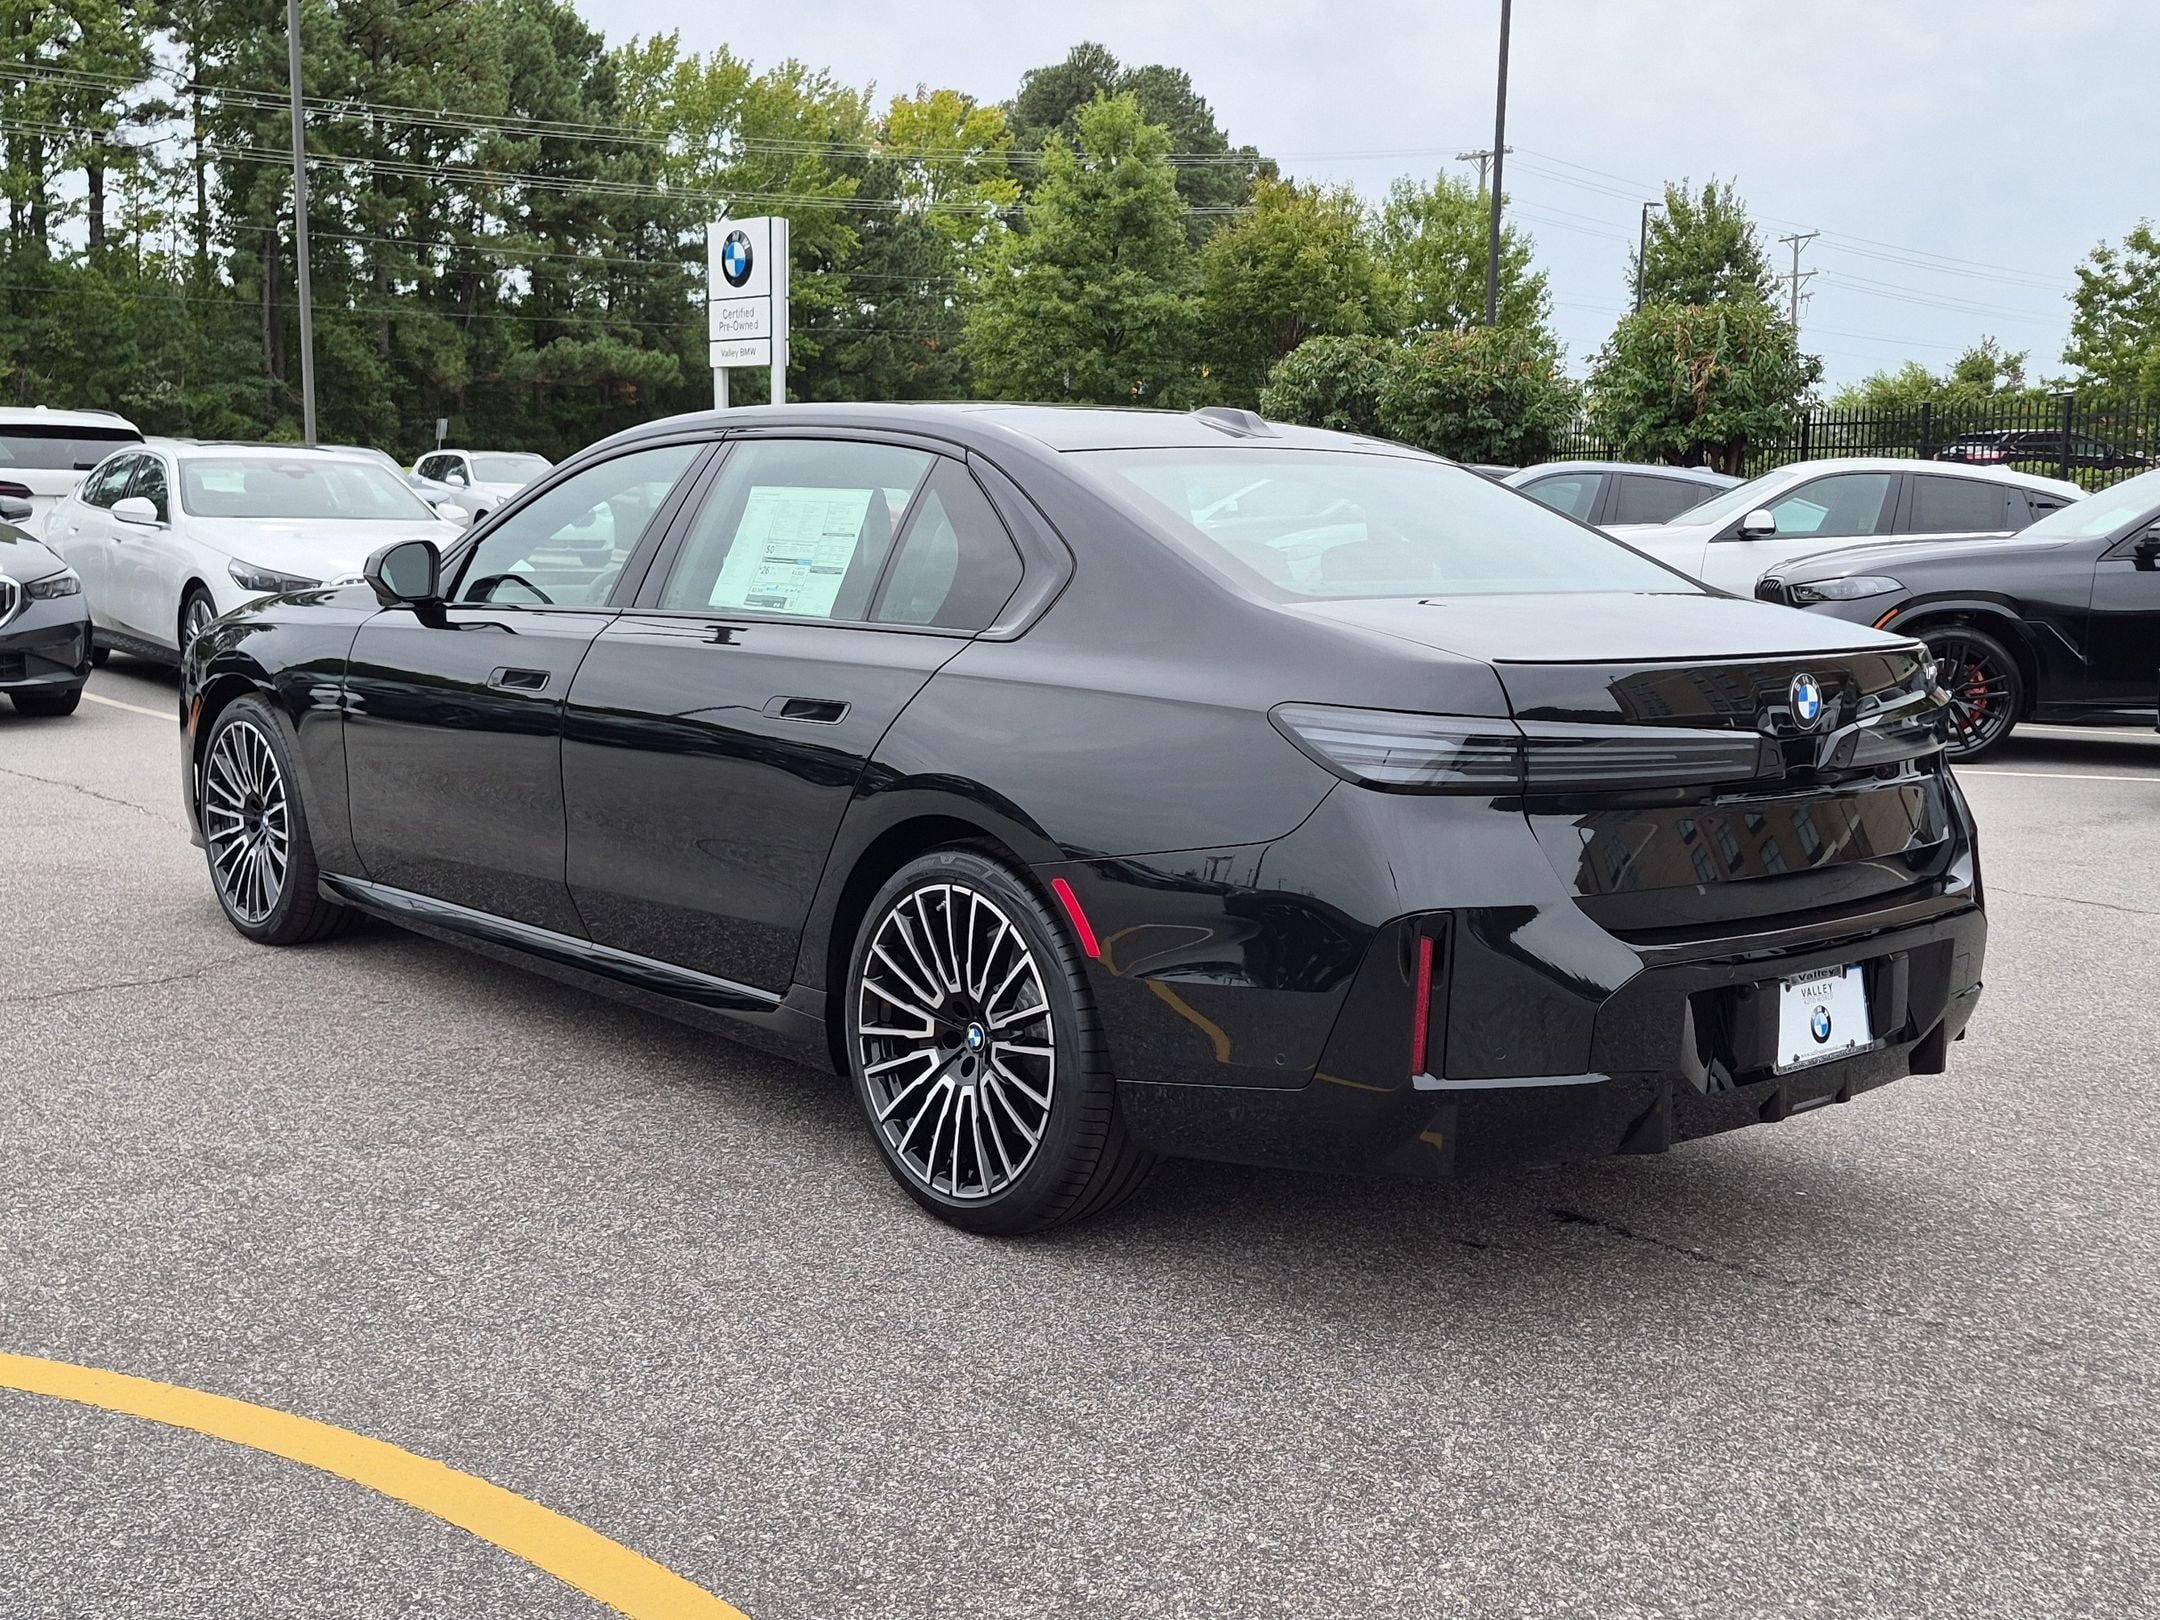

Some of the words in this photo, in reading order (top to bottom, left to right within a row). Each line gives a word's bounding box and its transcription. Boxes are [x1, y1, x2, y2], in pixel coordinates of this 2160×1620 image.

[724, 231, 750, 251] BMW
[722, 306, 755, 320] Certified
[718, 319, 759, 333] Pre-Owned
[720, 347, 739, 359] Valley
[739, 346, 757, 358] BMW
[1798, 968, 1835, 981] Valley
[1801, 983, 1833, 998] VALLEY
